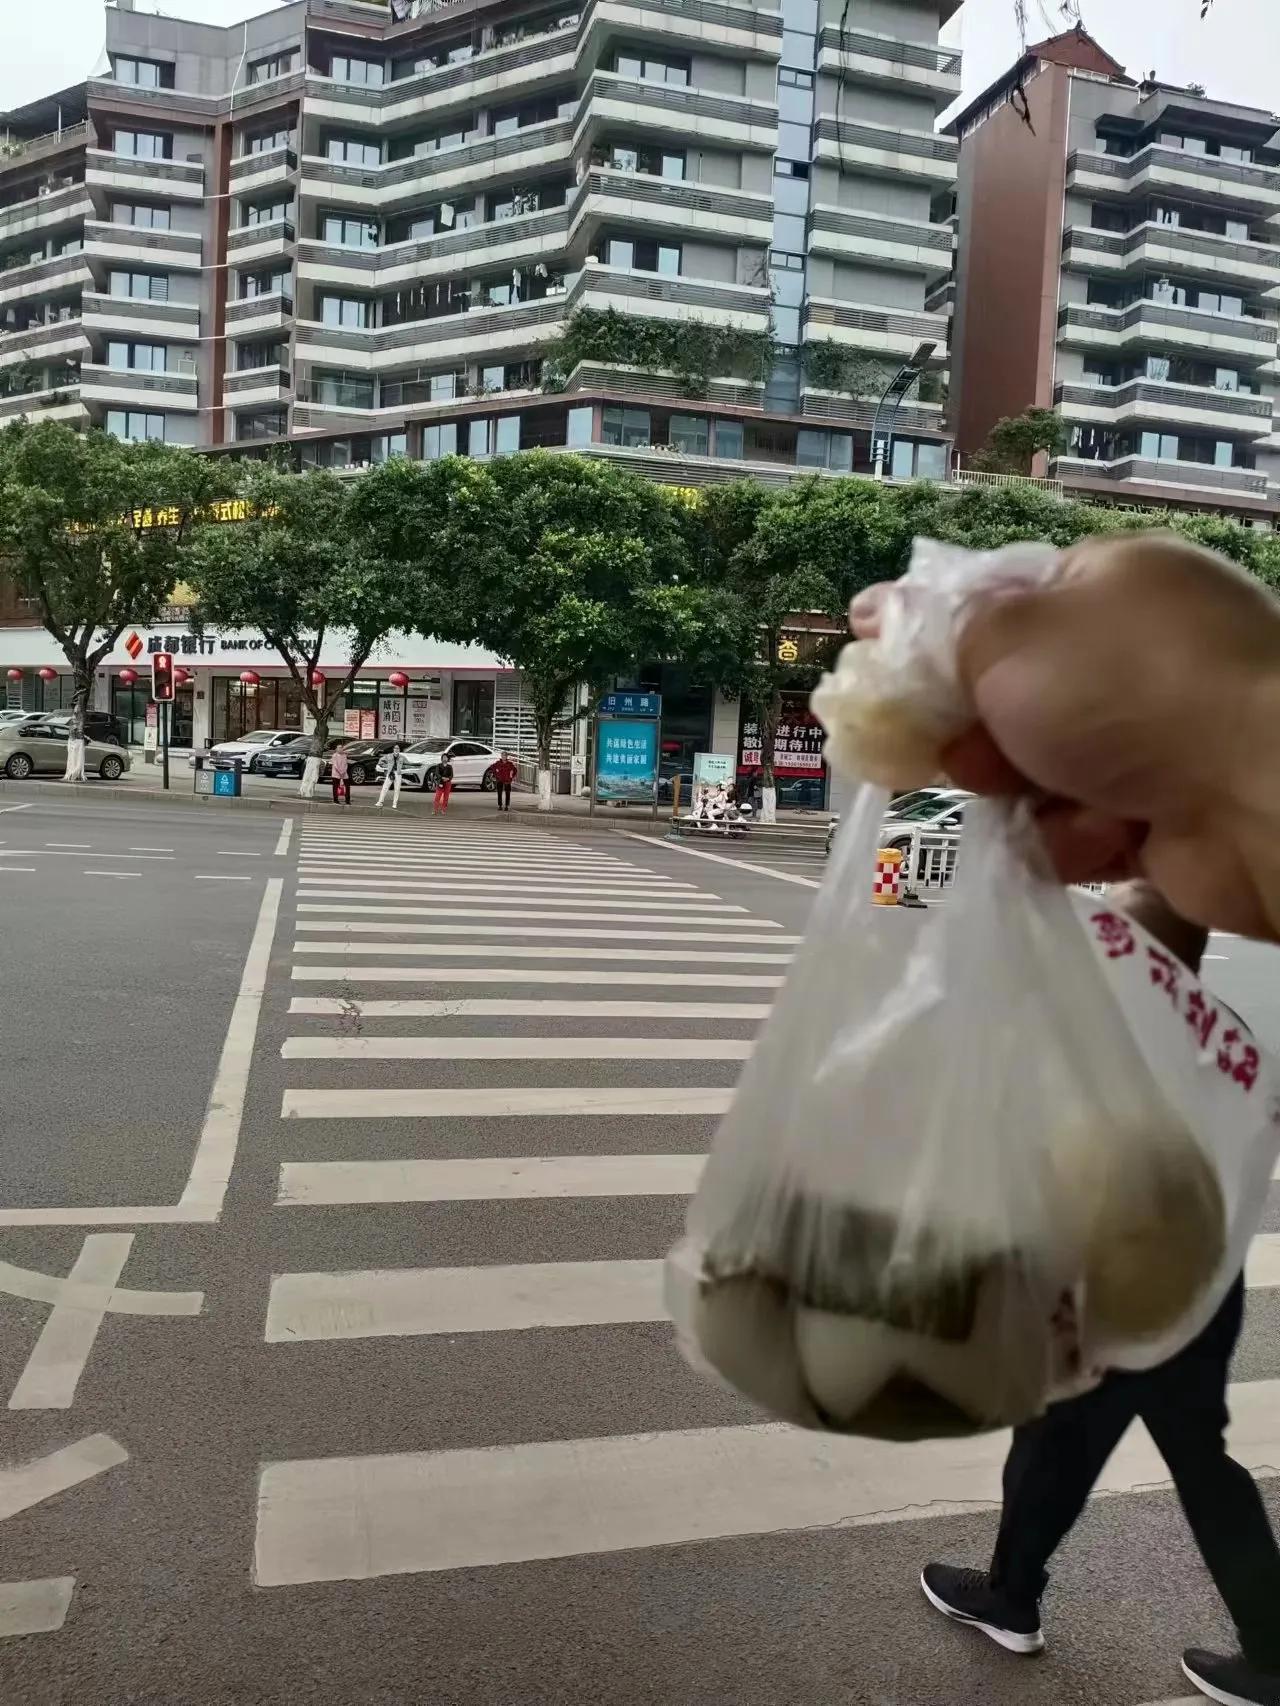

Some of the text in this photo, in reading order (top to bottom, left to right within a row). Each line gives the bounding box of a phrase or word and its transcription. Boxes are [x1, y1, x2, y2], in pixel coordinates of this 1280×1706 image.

[147, 635, 216, 655] 成都银行
[220, 639, 317, 651] BANK OF CHDU
[608, 697, 649, 707] 旧州路
[743, 722, 823, 739] 装进行中
